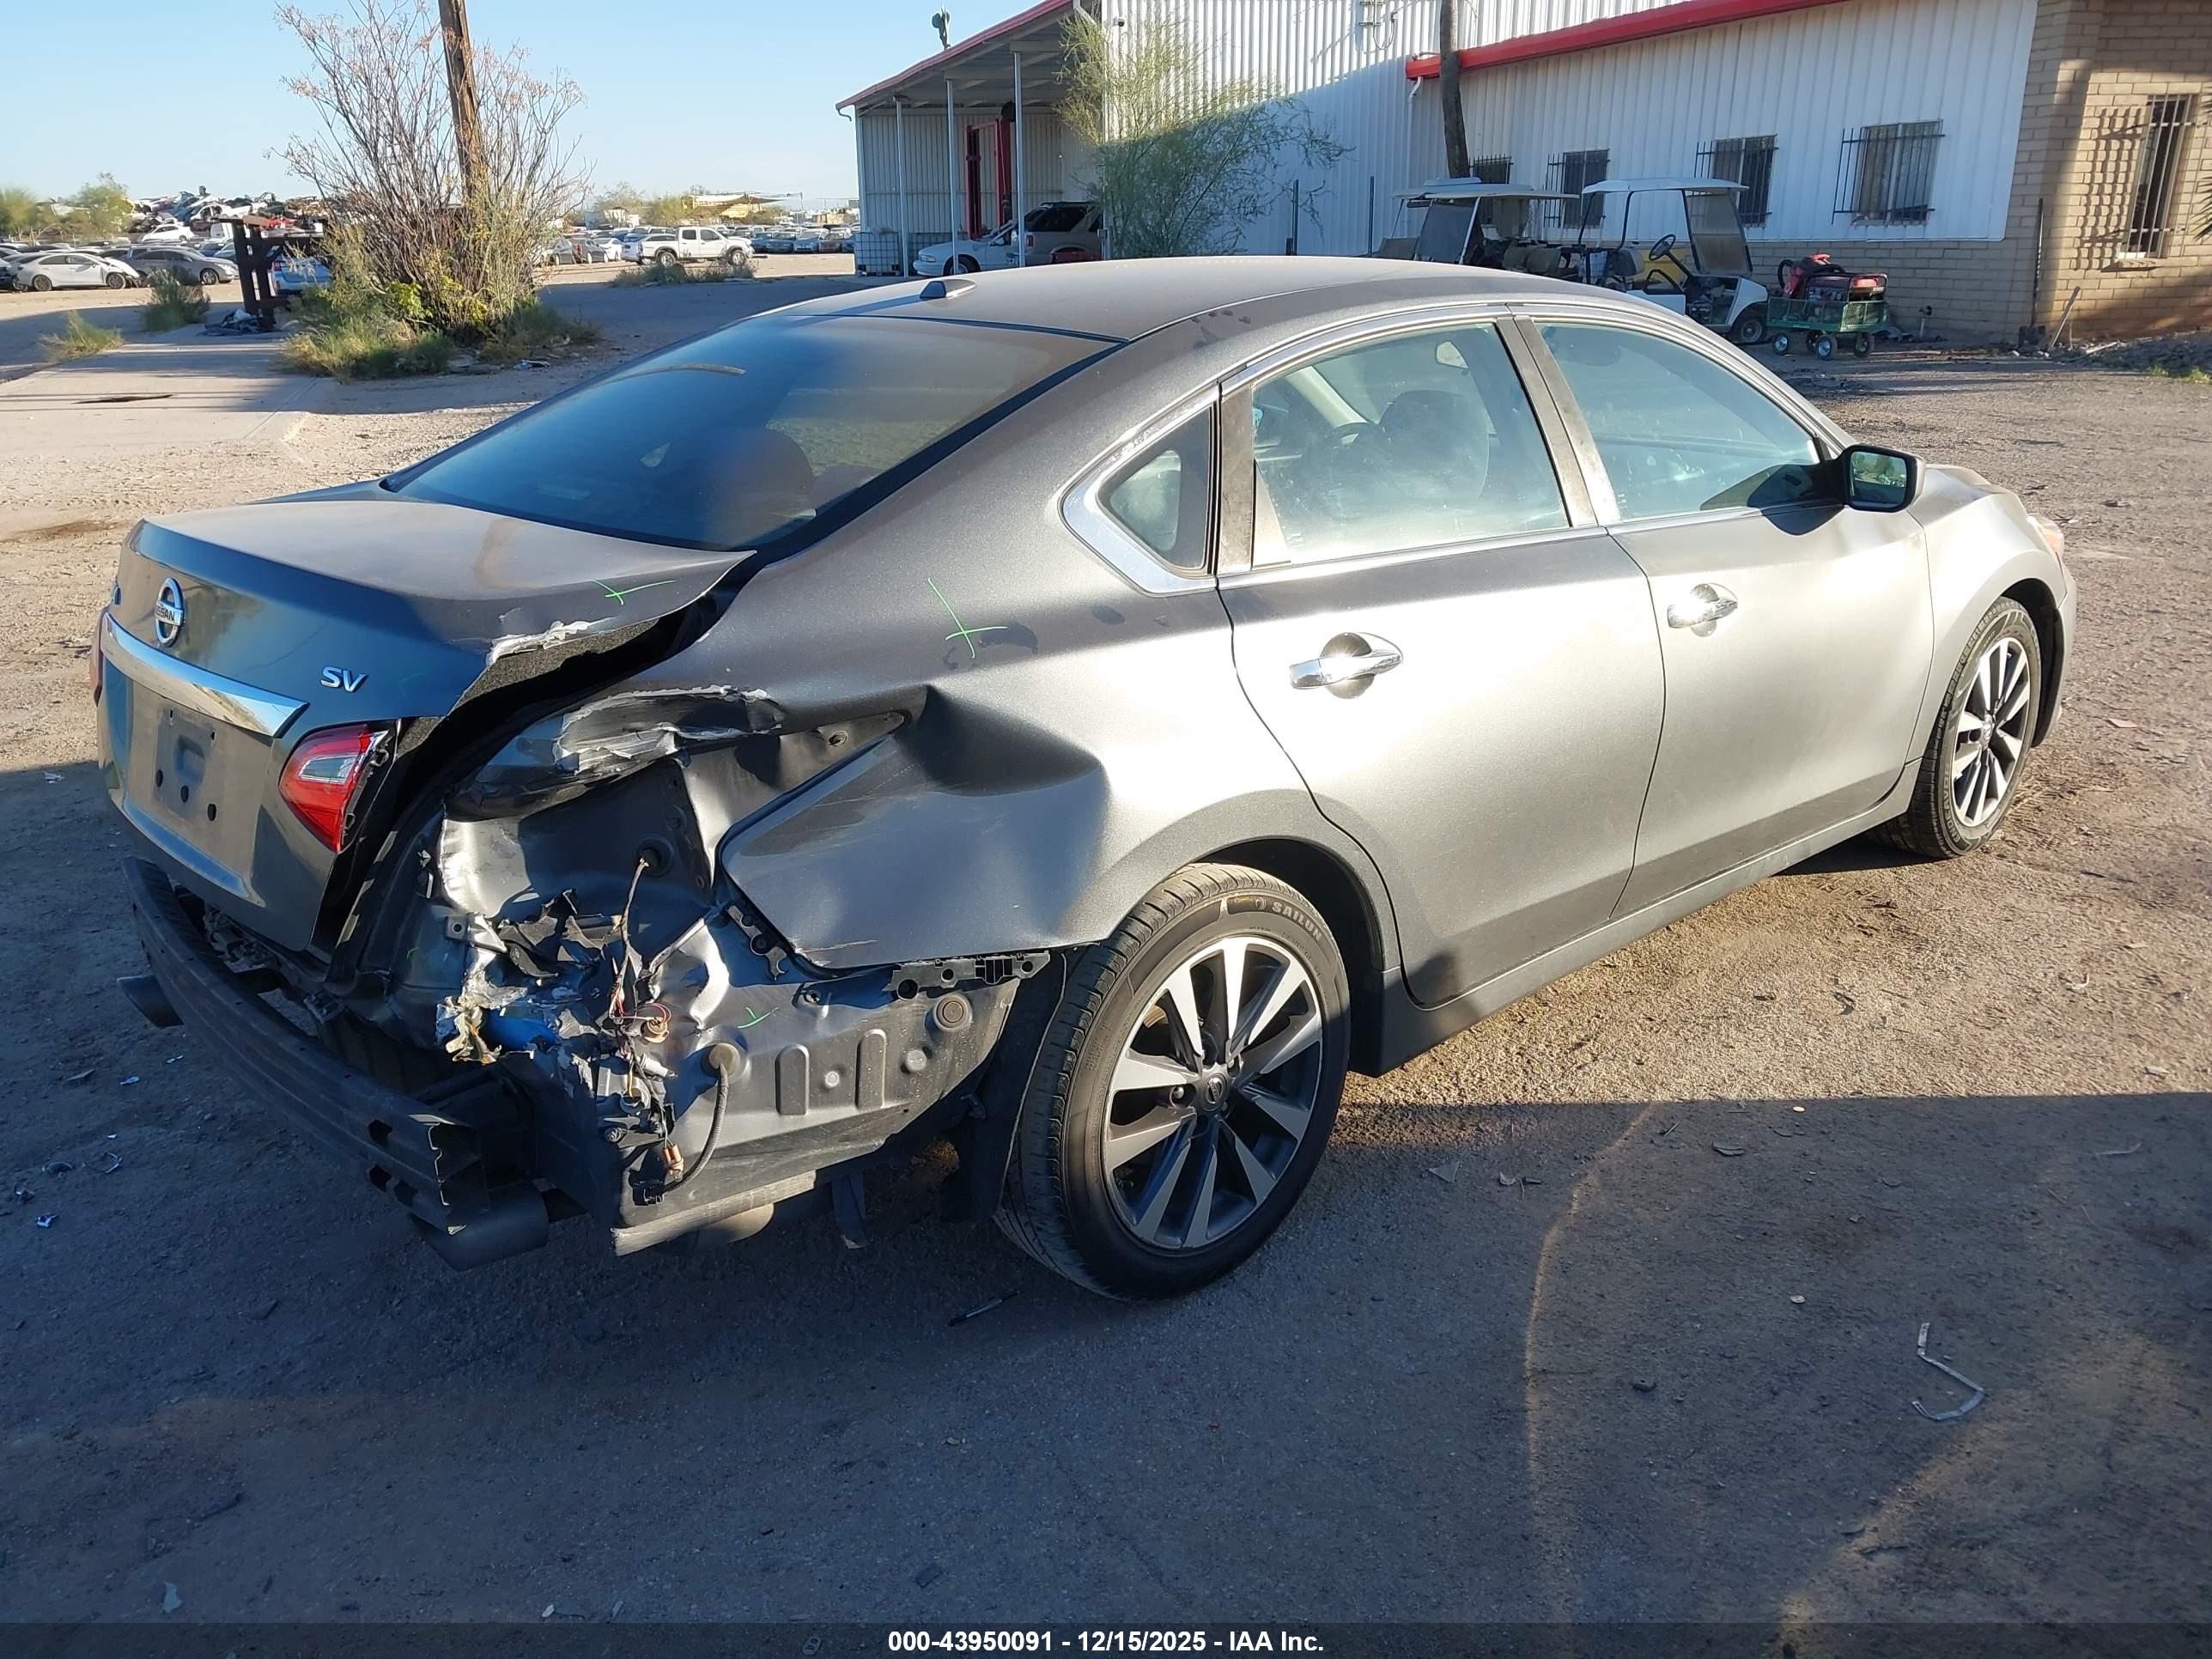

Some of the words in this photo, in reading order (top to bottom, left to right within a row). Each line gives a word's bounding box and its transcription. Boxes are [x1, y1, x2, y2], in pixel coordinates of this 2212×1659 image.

[155, 604, 175, 621] SSAN
[320, 665, 367, 693] SV
[1272, 902, 1323, 941] SAILUN
